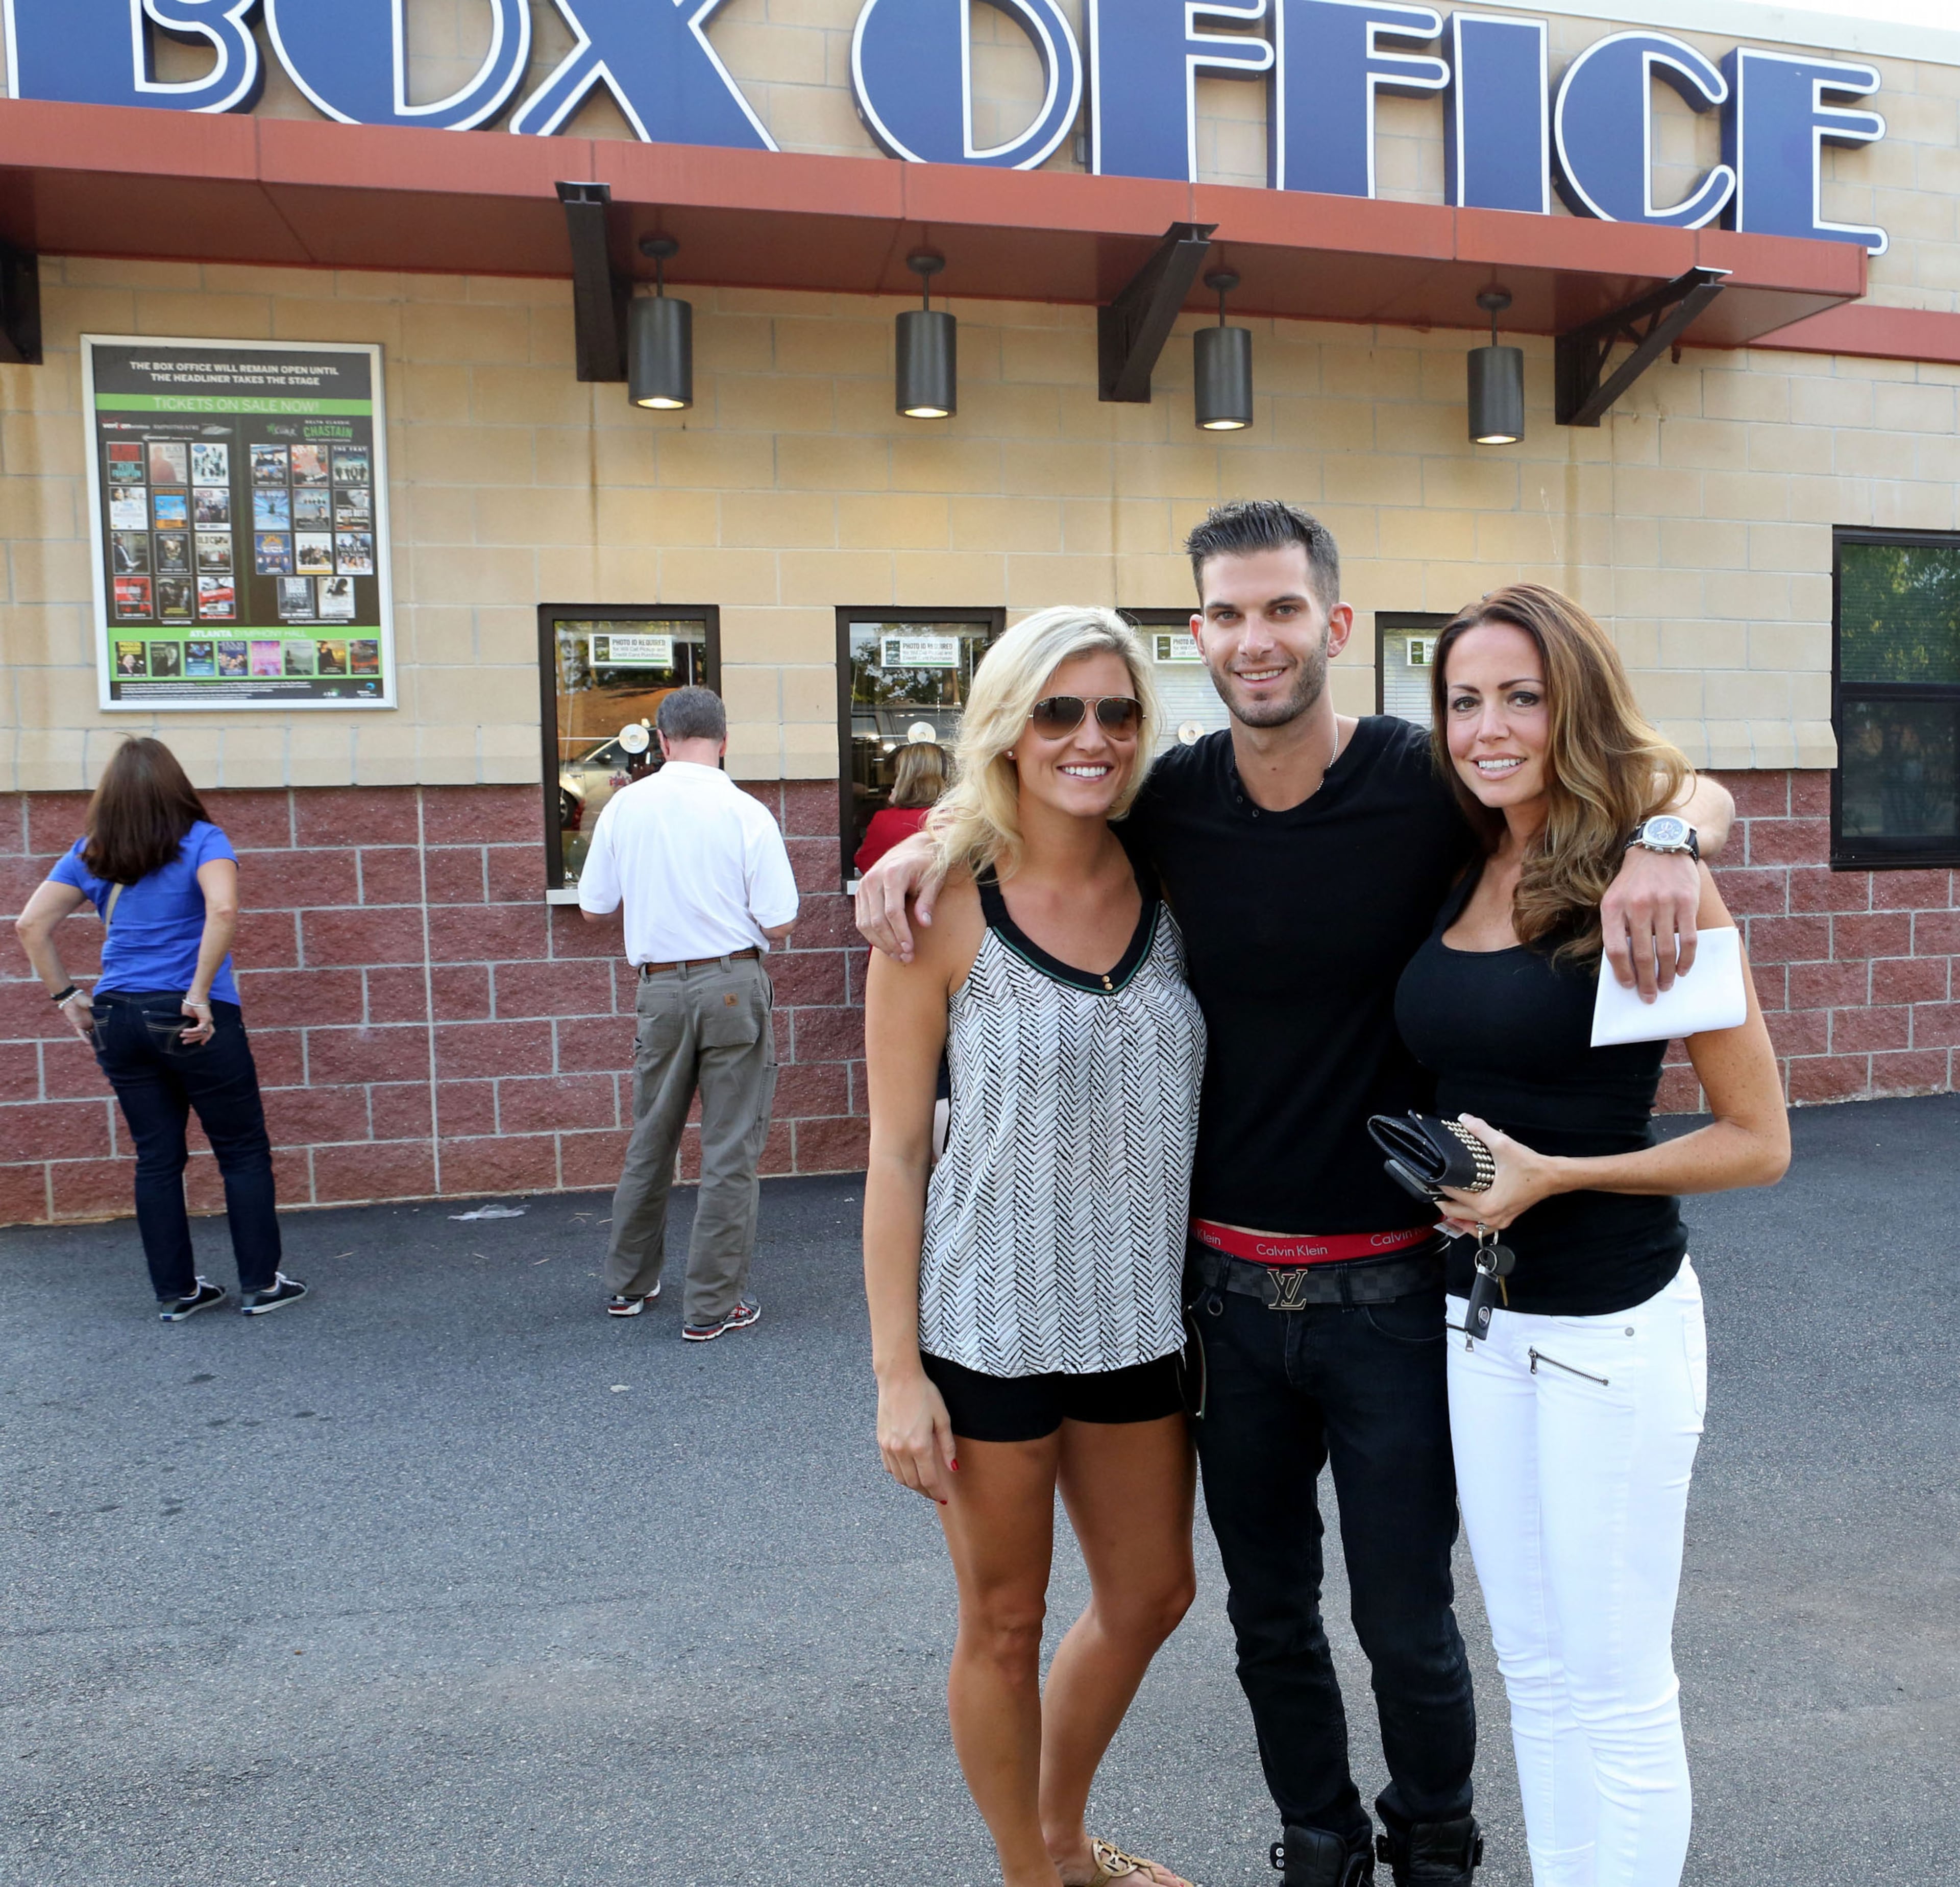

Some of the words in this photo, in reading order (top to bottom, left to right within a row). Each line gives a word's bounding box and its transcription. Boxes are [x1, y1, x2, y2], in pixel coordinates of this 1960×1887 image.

[4, 0, 780, 152] BOX
[851, 0, 1890, 257] OFFICE
[130, 361, 151, 371] THE
[153, 361, 174, 371] BOX
[176, 362, 212, 372] OFFICE
[213, 364, 238, 373] WILL
[239, 364, 279, 374] REMAIN
[280, 365, 309, 374] OPEN
[309, 366, 339, 376] UNTIL
[150, 373, 172, 382] THE
[173, 373, 231, 383] HEADLINER
[232, 375, 265, 384] TAKES
[266, 376, 287, 385] THE
[287, 376, 321, 386] STAGE
[154, 397, 213, 409] TICKETS
[216, 399, 239, 411] ON
[242, 399, 278, 412] SALE
[281, 400, 319, 413] NOW!
[303, 425, 354, 438] CHASTAIN
[189, 630, 233, 638] ATLANTA
[234, 630, 282, 638] SYMPHONY
[284, 630, 307, 638] HALL
[1196, 1228, 1221, 1246] Klein
[1370, 1229, 1413, 1247] Calvin
[1256, 1243, 1295, 1257] Calvin
[1296, 1243, 1328, 1257] Klein
